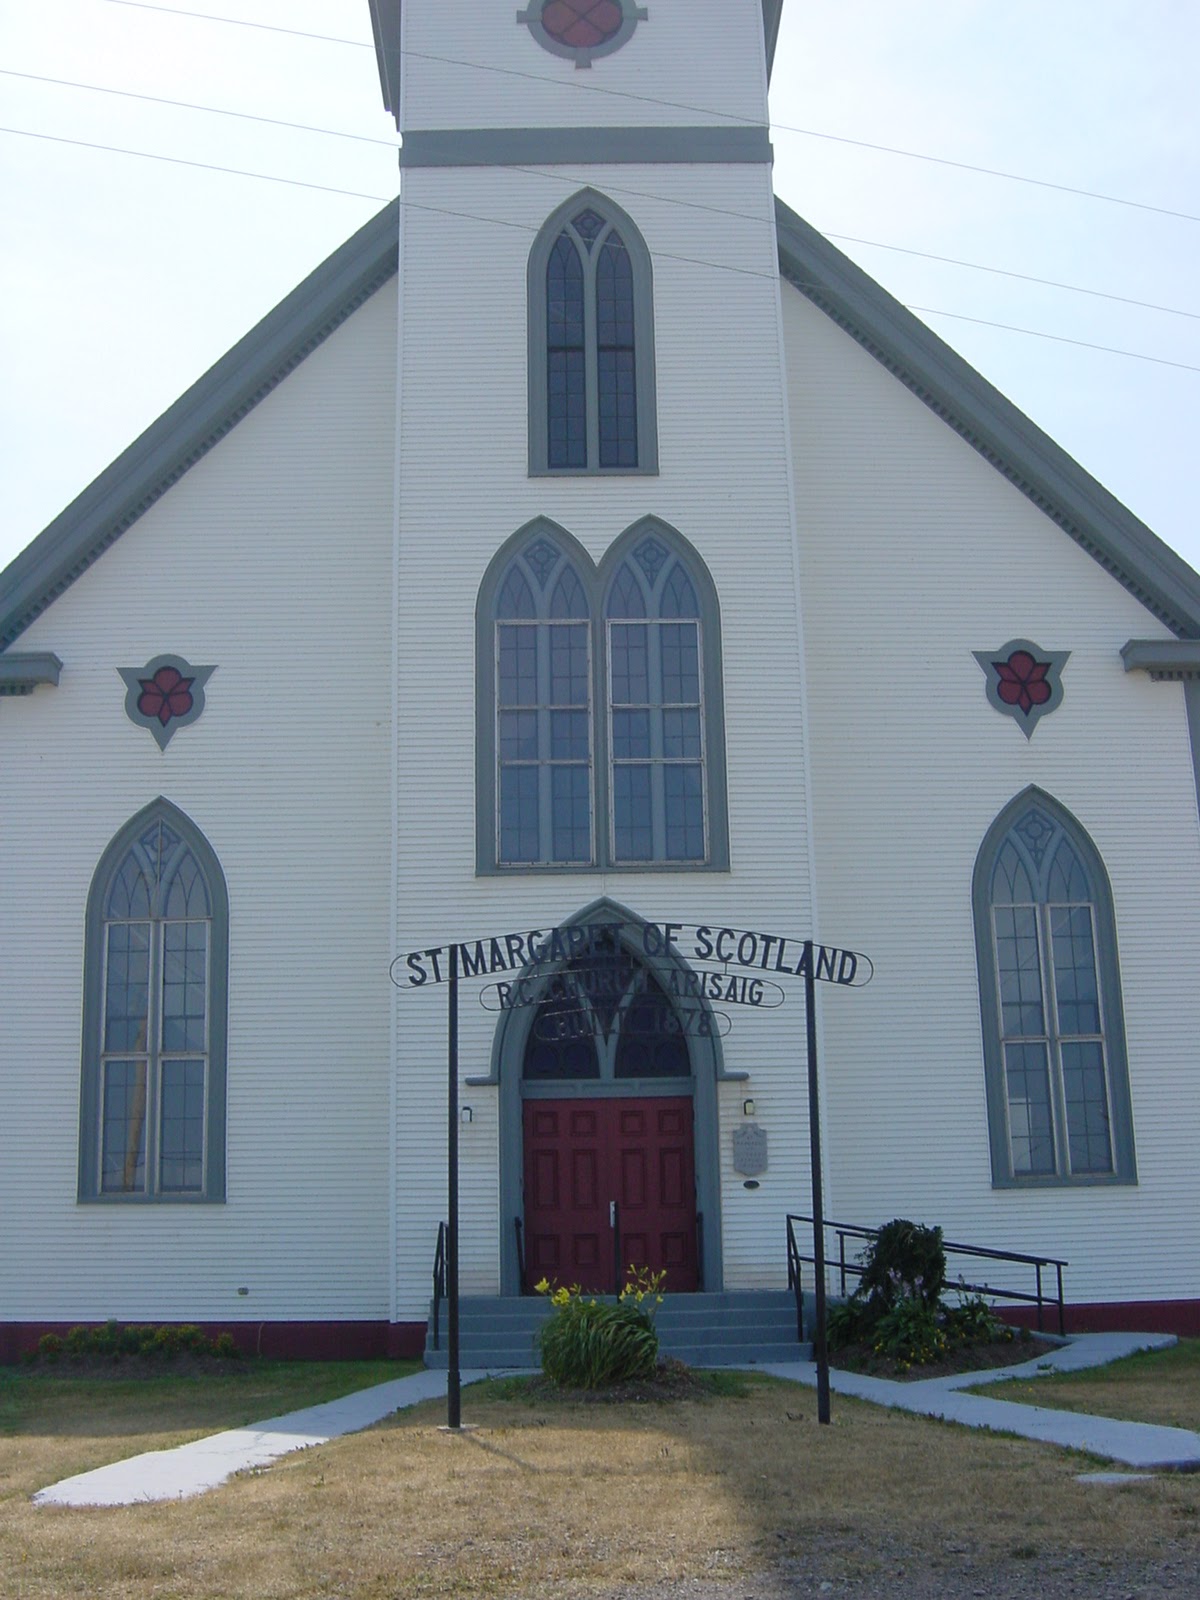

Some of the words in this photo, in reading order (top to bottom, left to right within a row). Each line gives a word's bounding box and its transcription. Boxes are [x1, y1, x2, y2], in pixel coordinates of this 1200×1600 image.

[406, 948, 442, 986] ST
[461, 924, 625, 977] MARGARET
[643, 924, 682, 956] OF
[694, 926, 858, 985] SCOTLAND
[668, 970, 763, 1006] ARISAIG
